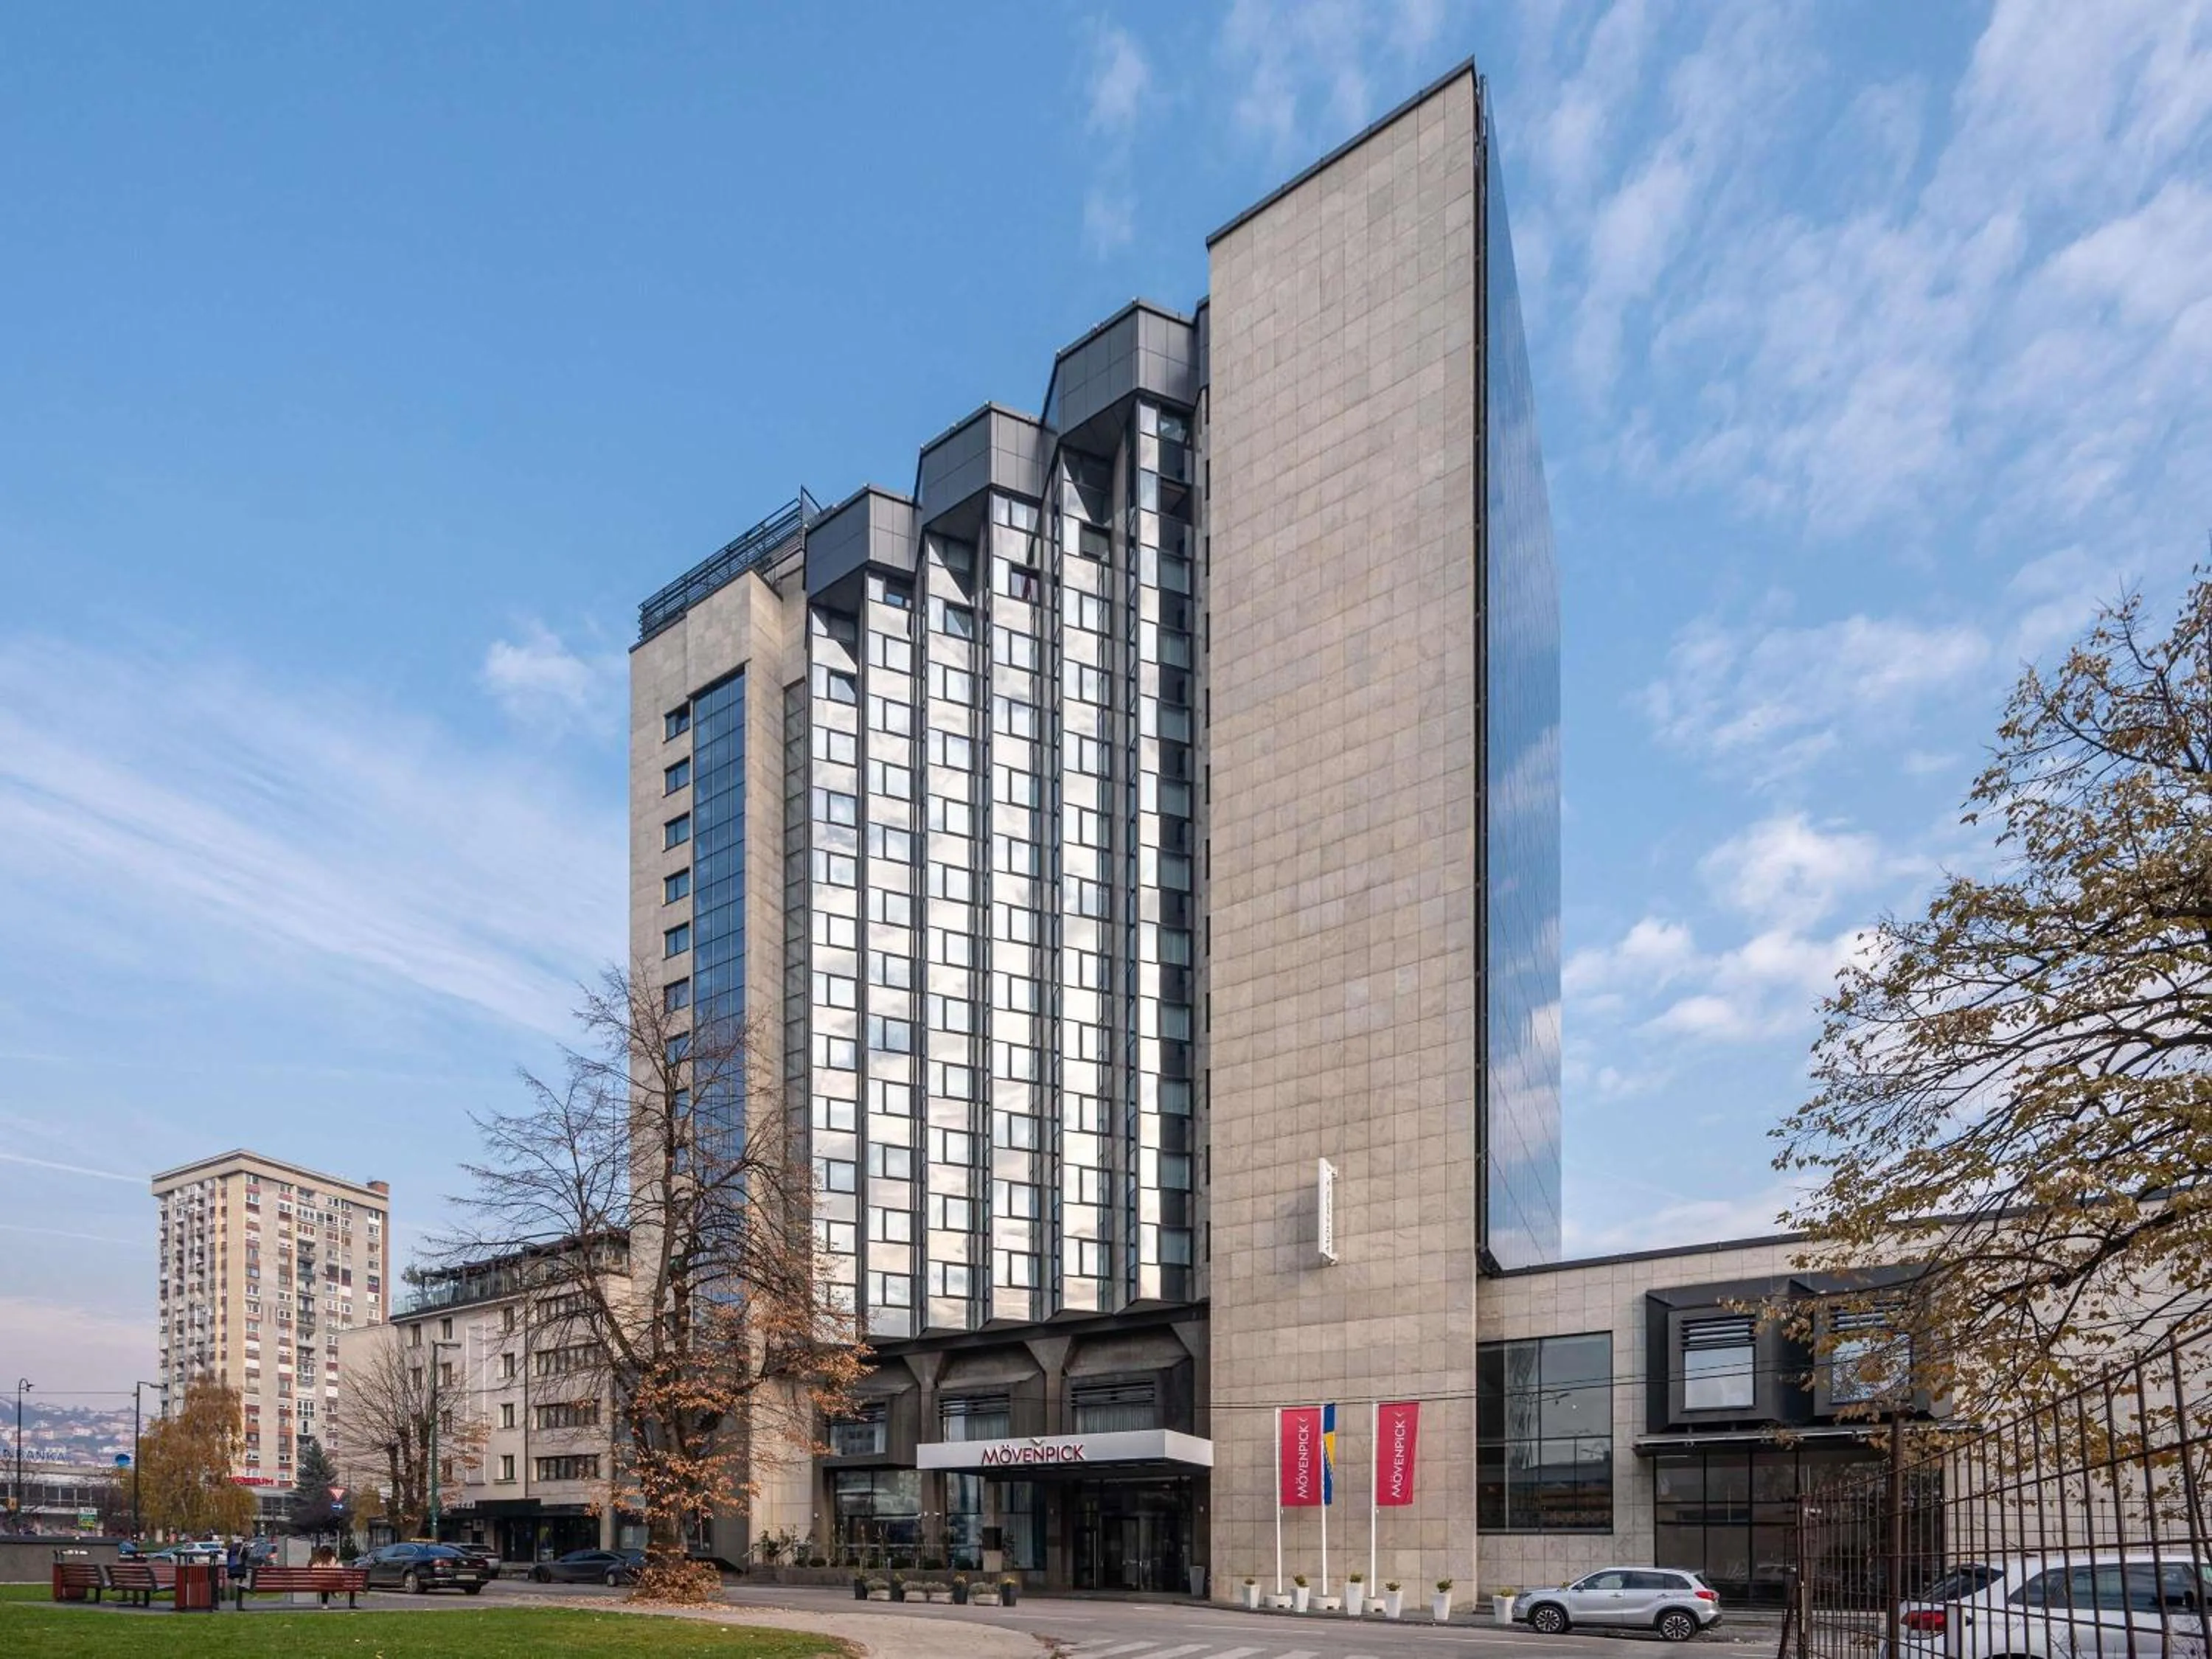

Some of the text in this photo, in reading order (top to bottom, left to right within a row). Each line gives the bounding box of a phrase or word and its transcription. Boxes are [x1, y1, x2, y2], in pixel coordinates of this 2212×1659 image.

[981, 1444, 1085, 1465] MÖVENPICK
[1295, 1425, 1310, 1499] MÖVENPICK
[1391, 1420, 1405, 1498] MÖVENPICK
